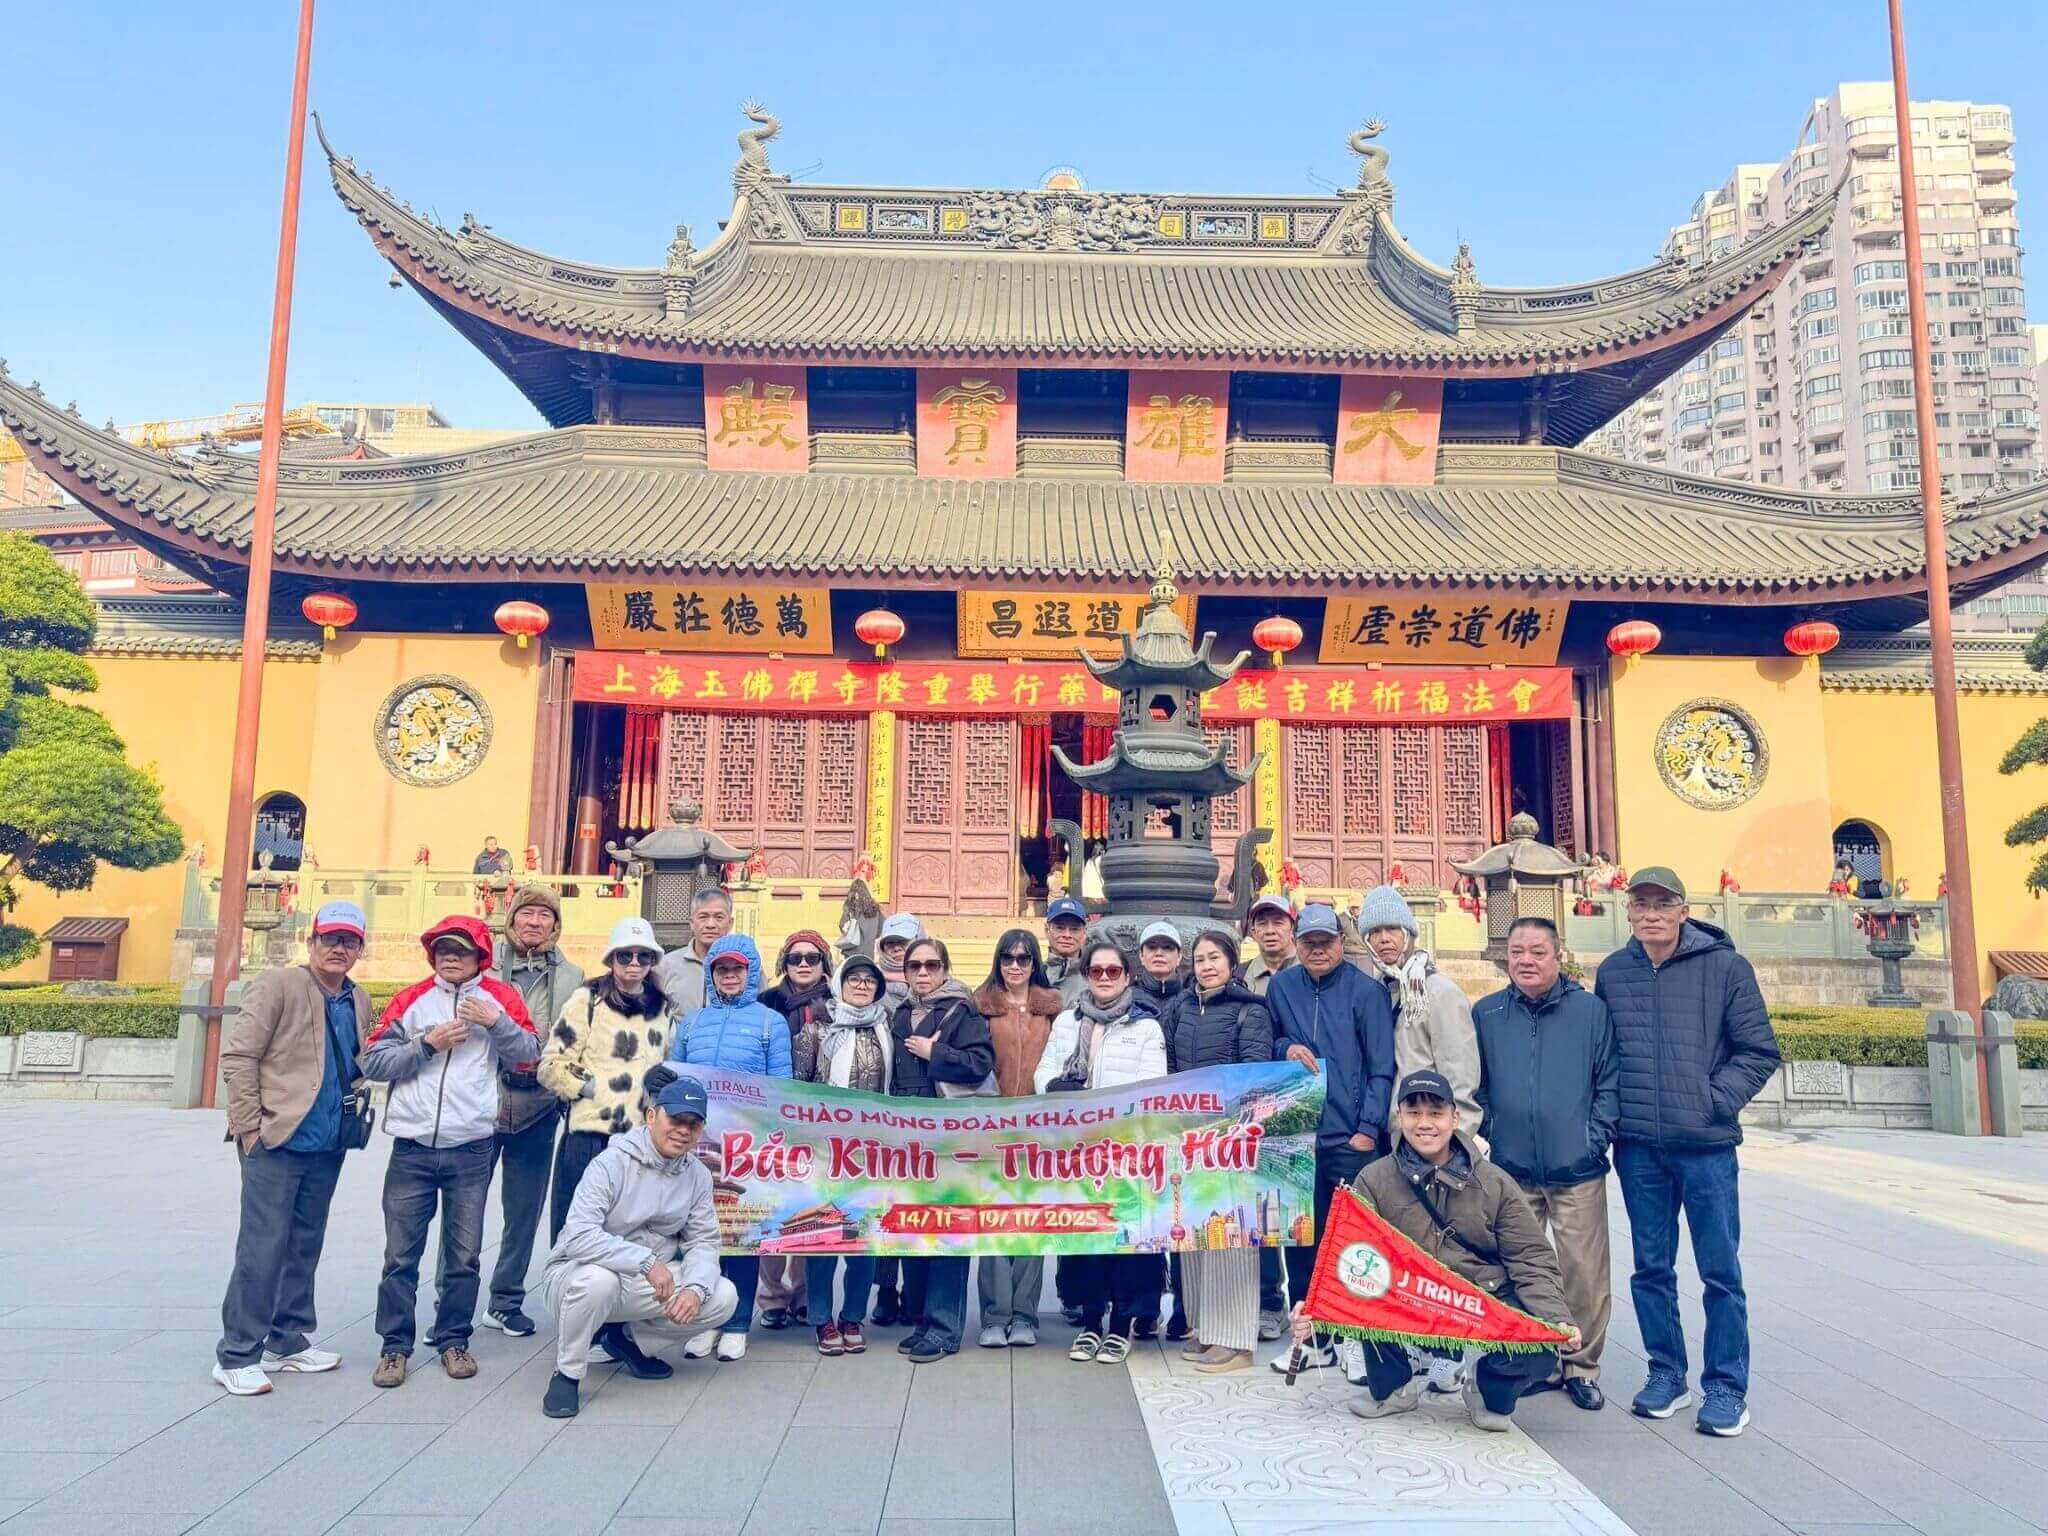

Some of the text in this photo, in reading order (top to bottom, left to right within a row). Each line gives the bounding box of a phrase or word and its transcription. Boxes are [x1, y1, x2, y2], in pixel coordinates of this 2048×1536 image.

[1343, 391, 1427, 462] 大
[780, 1093, 1224, 1131] CHÀO MỪNG ĐOÀN KHÁCH J TRAVEL
[721, 1128, 812, 1180] Bắc
[828, 1136, 935, 1179] Kinh
[994, 1139, 1166, 1192] Thượng
[1397, 1270, 1410, 1288] J
[1416, 1275, 1485, 1317] TRAVEL
